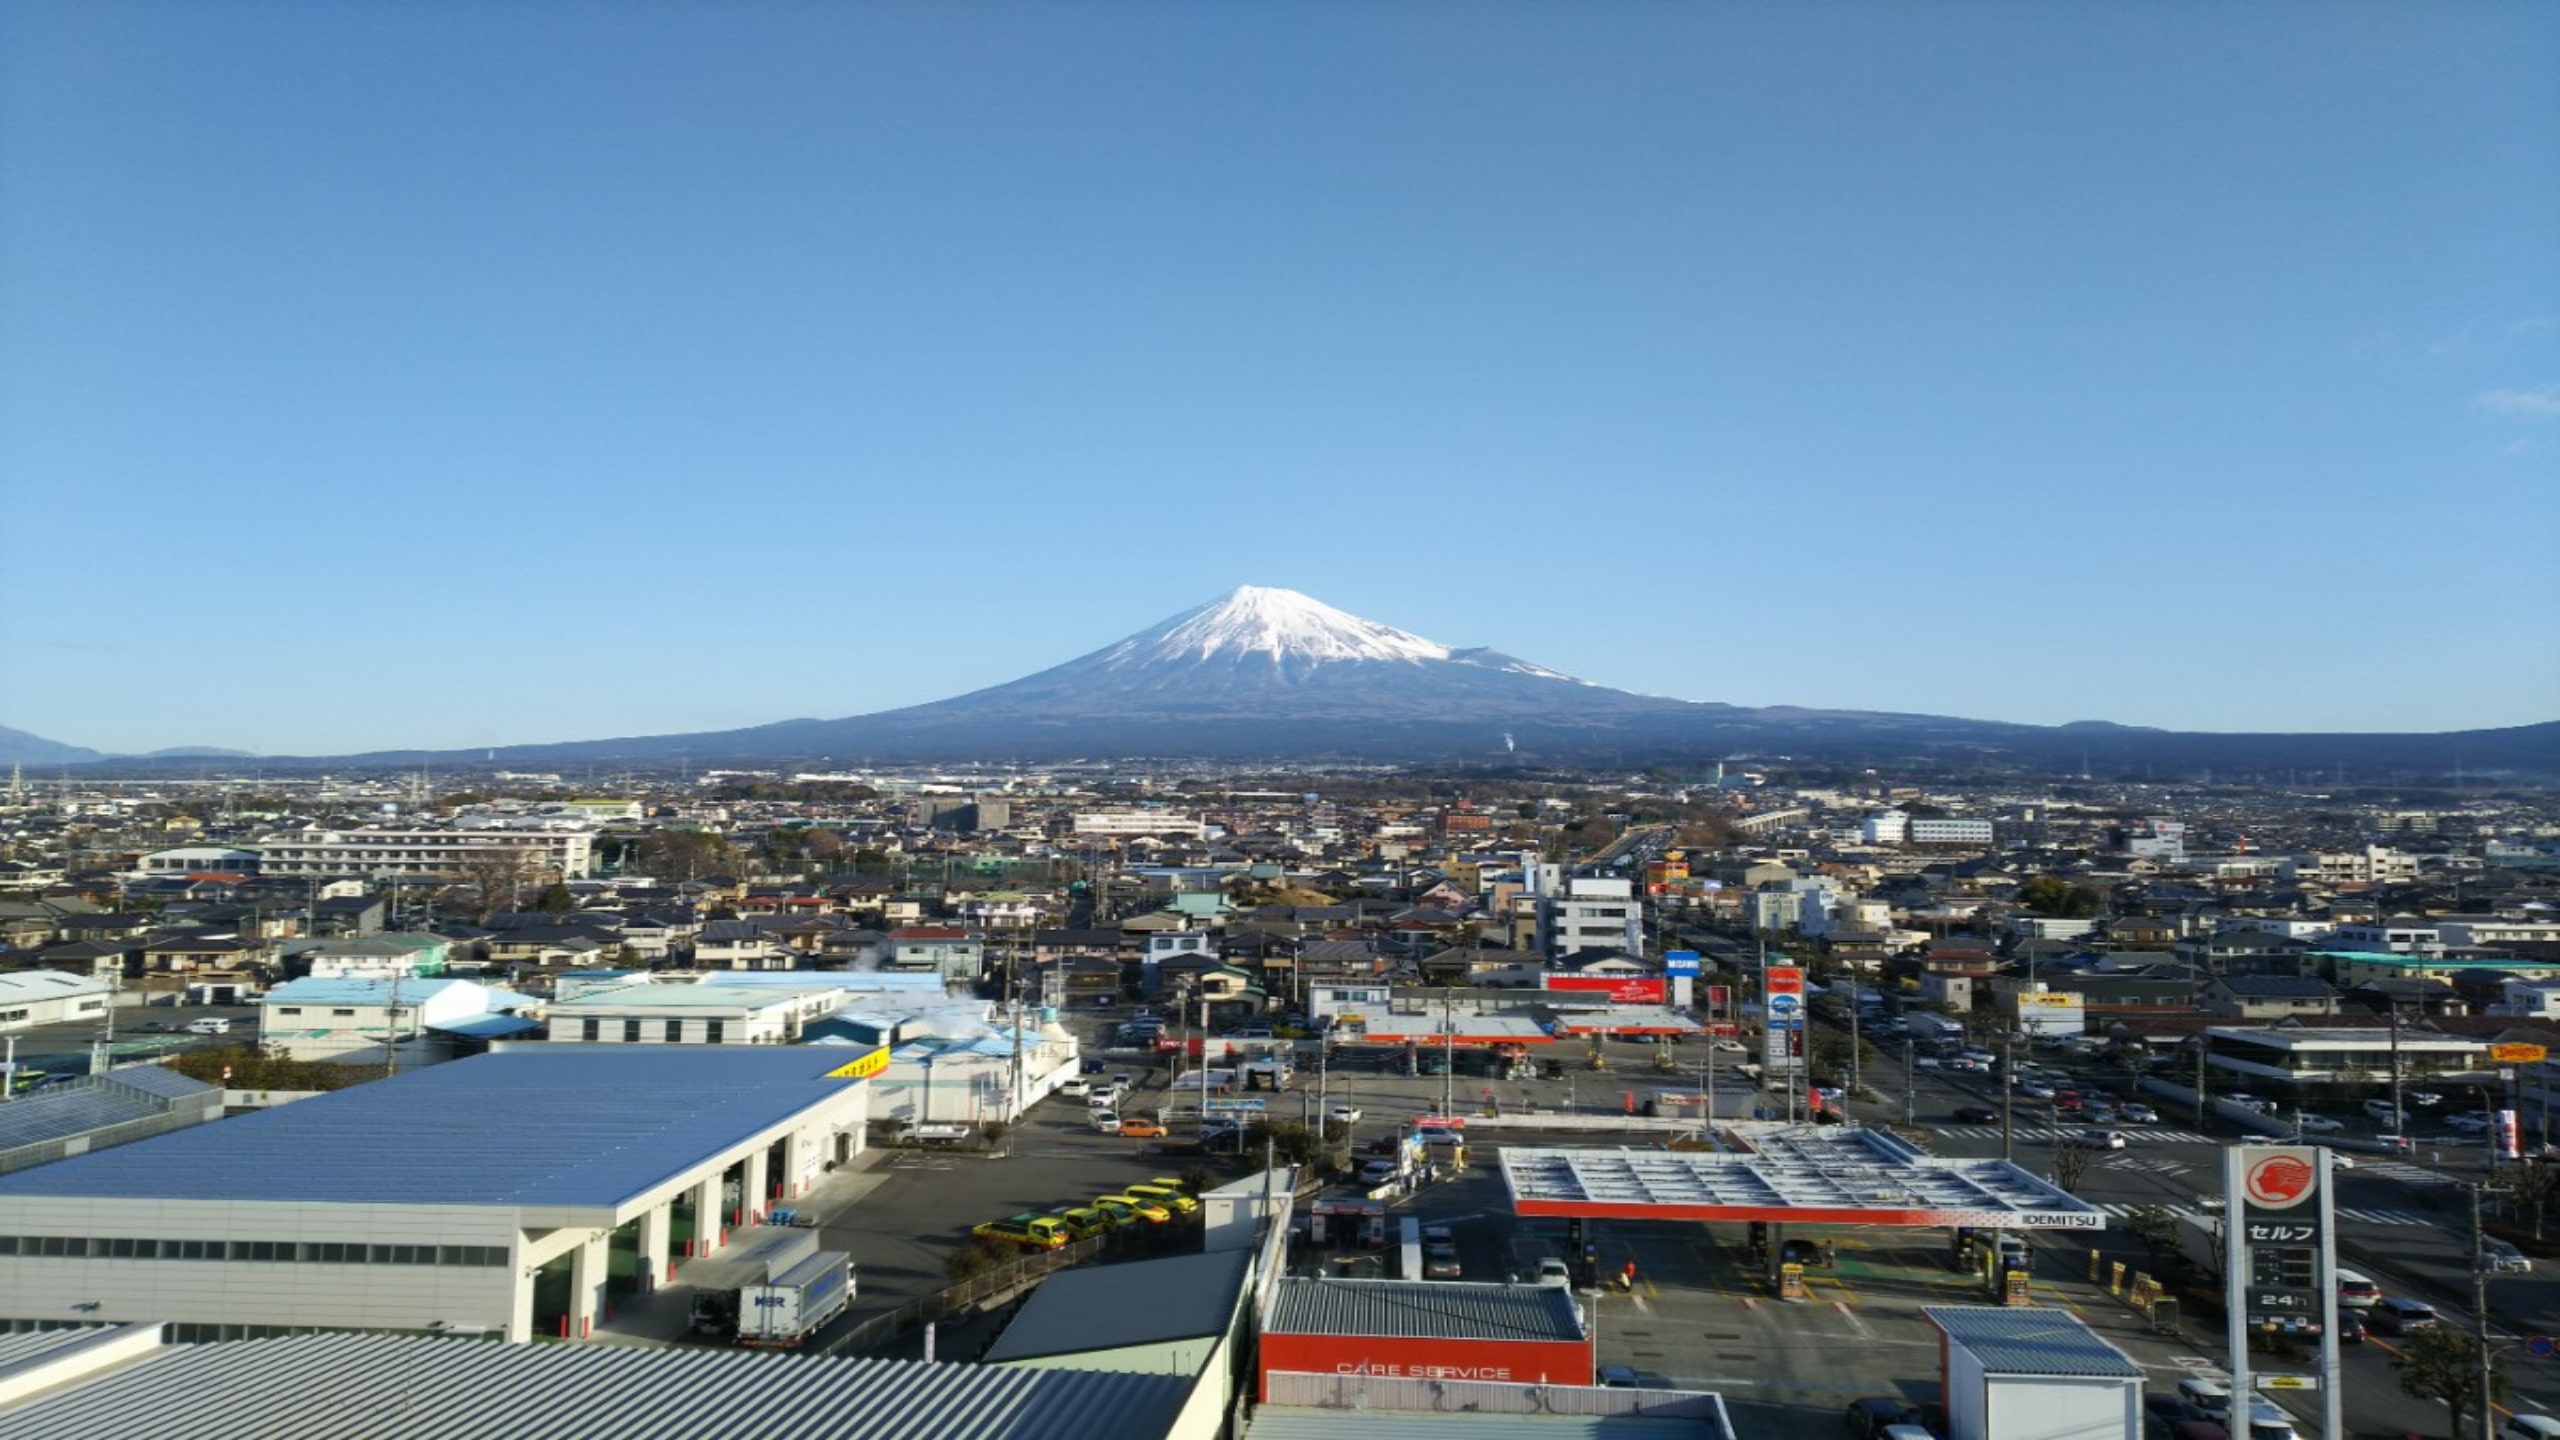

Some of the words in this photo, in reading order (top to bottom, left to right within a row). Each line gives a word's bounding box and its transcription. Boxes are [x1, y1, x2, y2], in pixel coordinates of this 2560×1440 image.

[2022, 1214, 2097, 1227] IDEMITSU
[2248, 1224, 2315, 1242] セルフ
[2260, 1294, 2307, 1307] 24h
[1336, 1363, 1401, 1376] CARE
[1408, 1366, 1512, 1381] SERVICE
